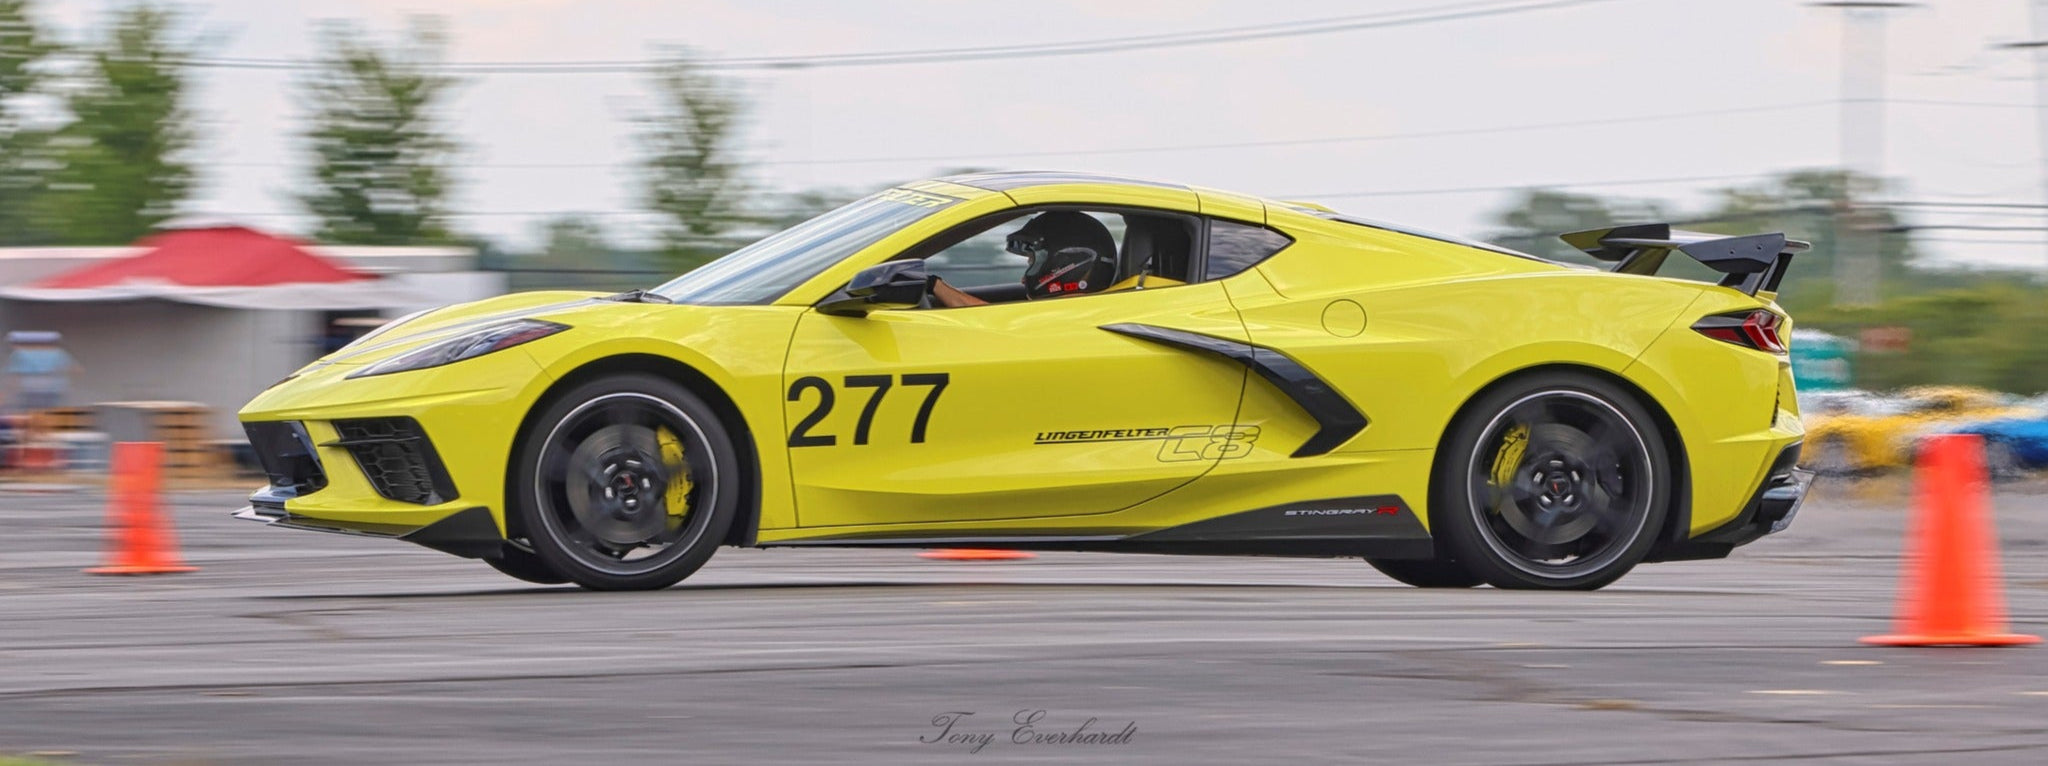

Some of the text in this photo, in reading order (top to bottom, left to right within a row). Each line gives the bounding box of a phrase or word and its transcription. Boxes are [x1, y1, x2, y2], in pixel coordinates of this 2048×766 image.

[787, 373, 950, 447] 277
[1035, 424, 1262, 463] LINGENFELTER C8
[1284, 507, 1377, 516] STINGRAY
